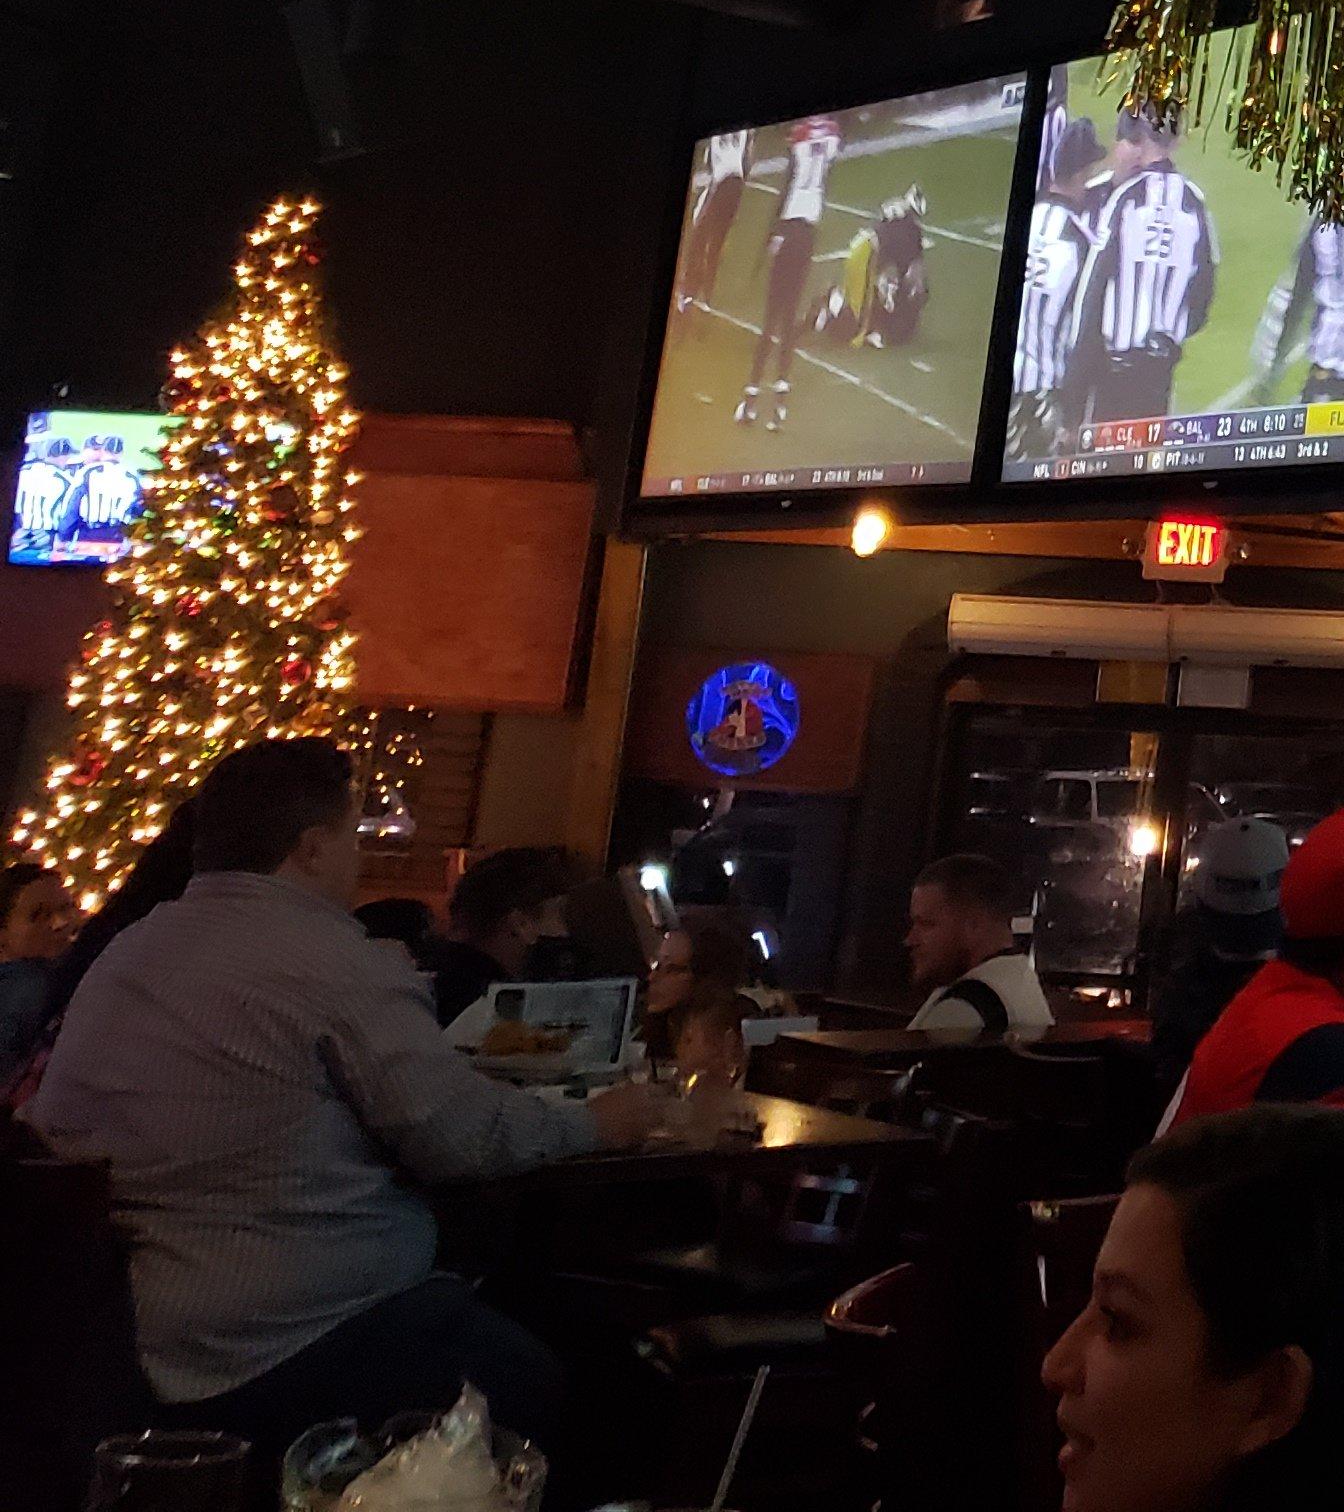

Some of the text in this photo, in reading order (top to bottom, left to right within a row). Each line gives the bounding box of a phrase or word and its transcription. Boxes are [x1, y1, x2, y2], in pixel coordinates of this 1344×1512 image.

[1117, 427, 1133, 442] CLE
[1148, 423, 1161, 443] 17
[1186, 420, 1203, 436] BAL
[1216, 417, 1232, 437] 23
[1239, 417, 1258, 434] 4TH
[1263, 414, 1286, 432] 8:10
[1033, 464, 1050, 479] NFL
[1071, 460, 1087, 476] CIN
[1133, 455, 1143, 470] 10
[1166, 451, 1182, 467] PIT
[1159, 522, 1217, 565] EXIT
